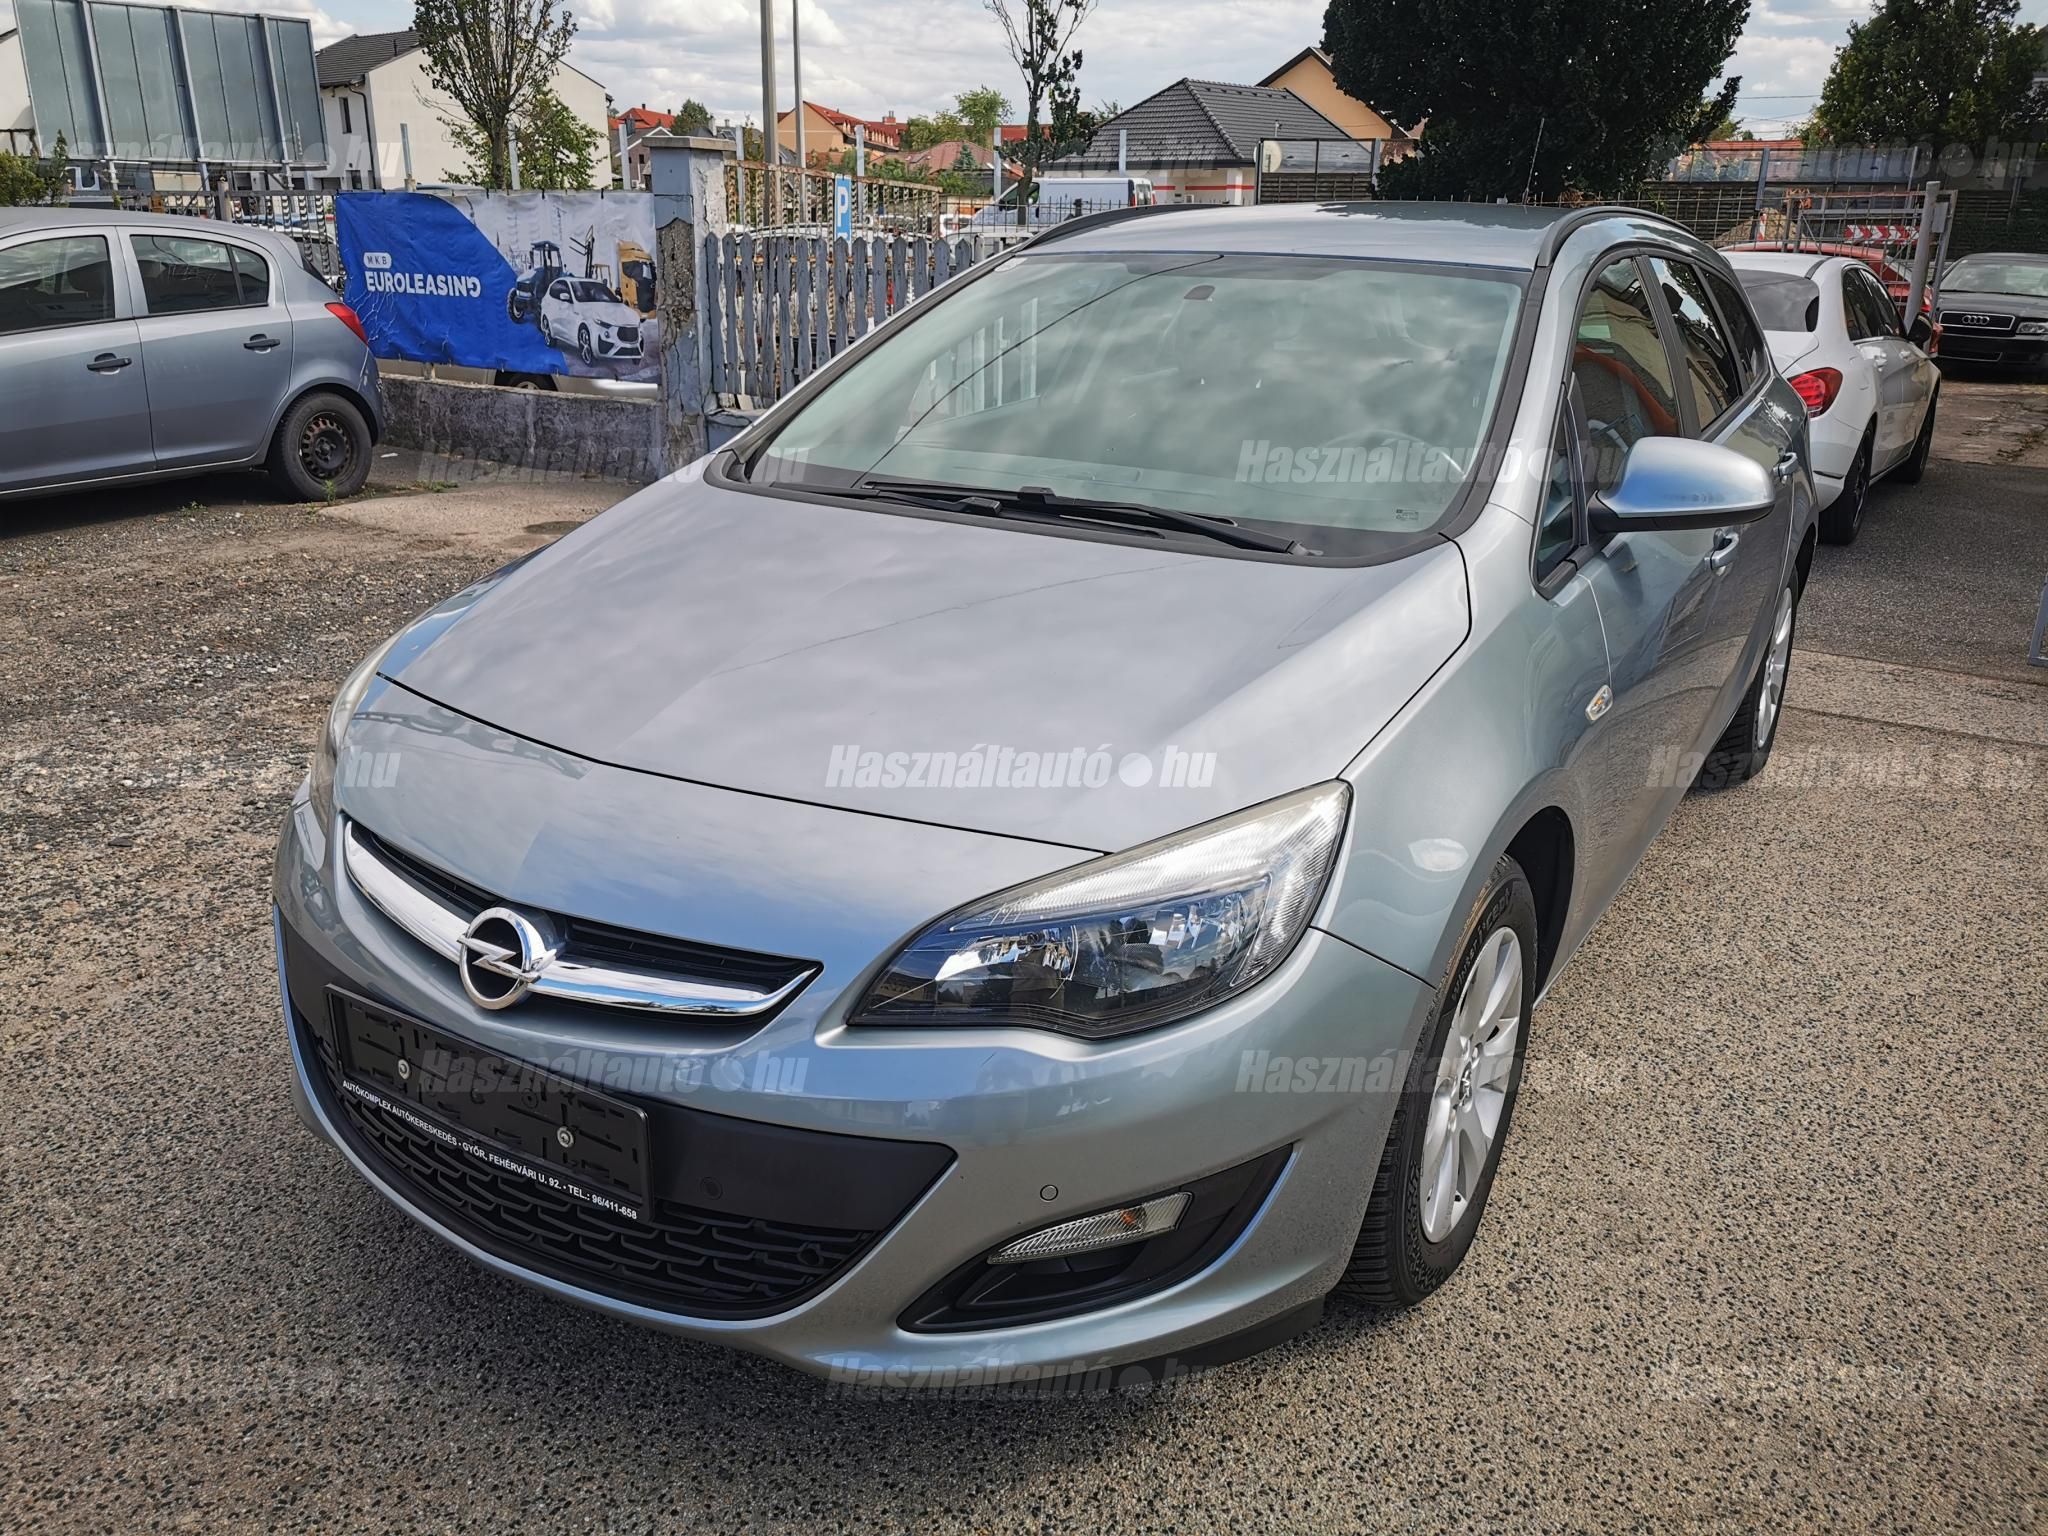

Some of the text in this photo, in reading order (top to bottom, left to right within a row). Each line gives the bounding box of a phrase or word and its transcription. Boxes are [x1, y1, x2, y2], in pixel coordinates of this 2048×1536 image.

[837, 186, 849, 227] P
[366, 255, 388, 266] MKB
[342, 1079, 392, 1112] AUTÓKOMPLEX
[392, 1105, 457, 1146] AUTÓKERESKEDÉS
[489, 1153, 537, 1180] FEHÉRVÁRI
[538, 1173, 548, 1184] U.
[567, 1184, 590, 1201] TEL.:
[592, 1194, 637, 1220] 96/411-658
